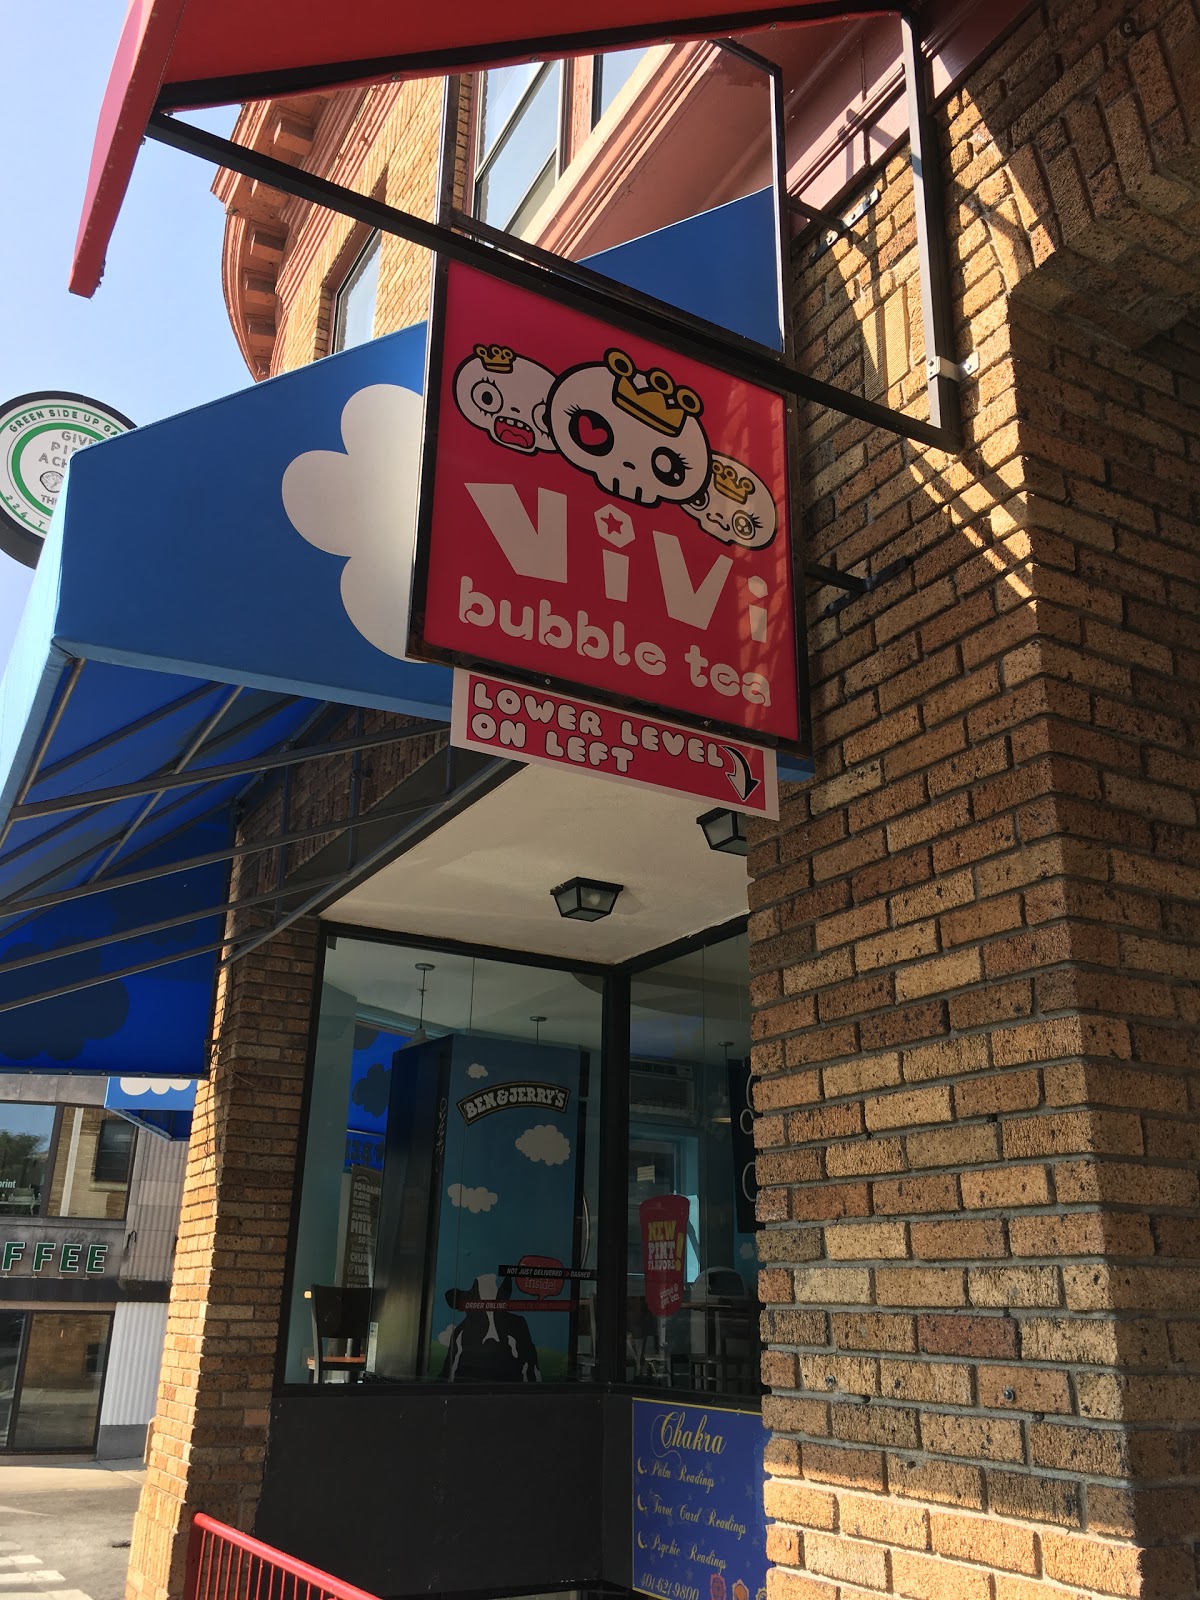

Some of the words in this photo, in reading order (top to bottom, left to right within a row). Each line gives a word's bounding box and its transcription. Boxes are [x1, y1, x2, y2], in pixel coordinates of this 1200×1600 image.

[9, 411, 45, 433] GREEN
[49, 409, 78, 418] SIDE
[84, 414, 100, 425] UP
[464, 483, 769, 643] ViVi
[459, 575, 667, 676] bubble
[684, 644, 772, 707] tea
[472, 682, 604, 738] LOWER
[621, 720, 725, 769] LEVEL
[471, 713, 527, 749] ON
[545, 732, 634, 773] LEFT
[350, 1220, 372, 1237] MILK
[647, 1220, 677, 1241] NEW
[2, 1241, 109, 1274] FFEE
[647, 1241, 676, 1260] PINT
[506, 1267, 519, 1275] NOT
[519, 1268, 533, 1276] JUST
[533, 1268, 563, 1277] DELIVERED
[570, 1270, 591, 1279] DASHED
[465, 1301, 485, 1309] ORDER
[652, 1411, 728, 1455] Chakra
[651, 1460, 672, 1479] Palm
[679, 1464, 715, 1493] Readings
[653, 1493, 673, 1517] Tarot
[679, 1503, 703, 1523] Card
[707, 1508, 747, 1540] Readings
[652, 1534, 681, 1558] Psychic
[688, 1543, 727, 1575] Readings
